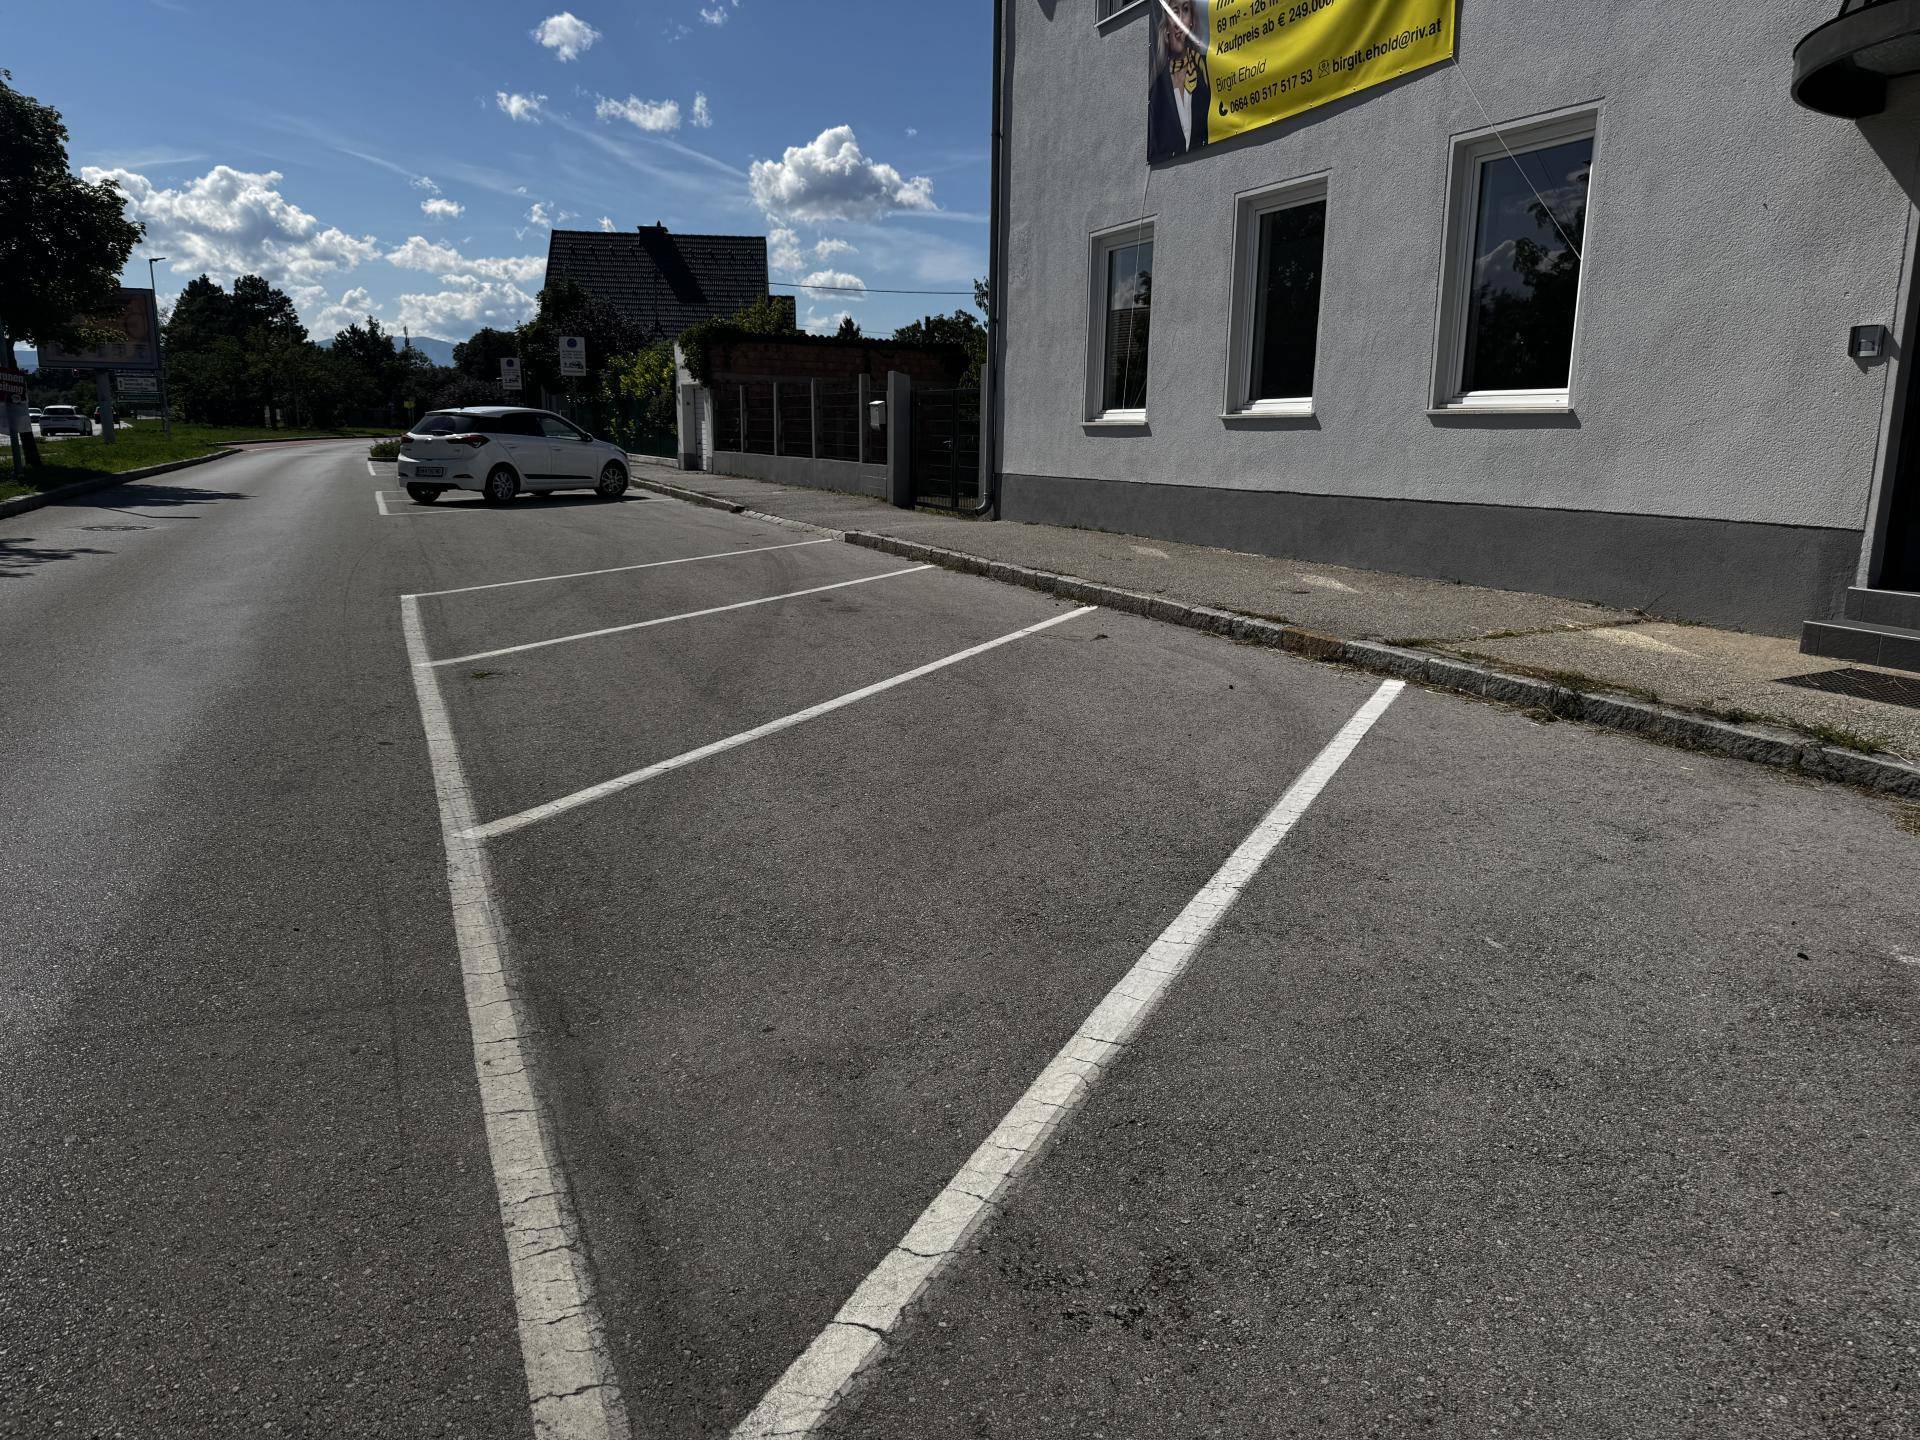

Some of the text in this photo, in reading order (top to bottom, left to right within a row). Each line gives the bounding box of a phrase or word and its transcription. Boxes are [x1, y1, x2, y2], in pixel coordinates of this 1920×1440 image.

[1216, 26, 1259, 55] Kaufpreis
[1262, 18, 1275, 35] ab
[1277, 12, 1285, 27] €
[1217, 18, 1227, 33] 69
[1250, 0, 1266, 16] 126
[1216, 59, 1267, 92] Birgit Ehold
[1230, 18, 1442, 113] 0664 60 517 517 53 birgit.ehold@riv.at
